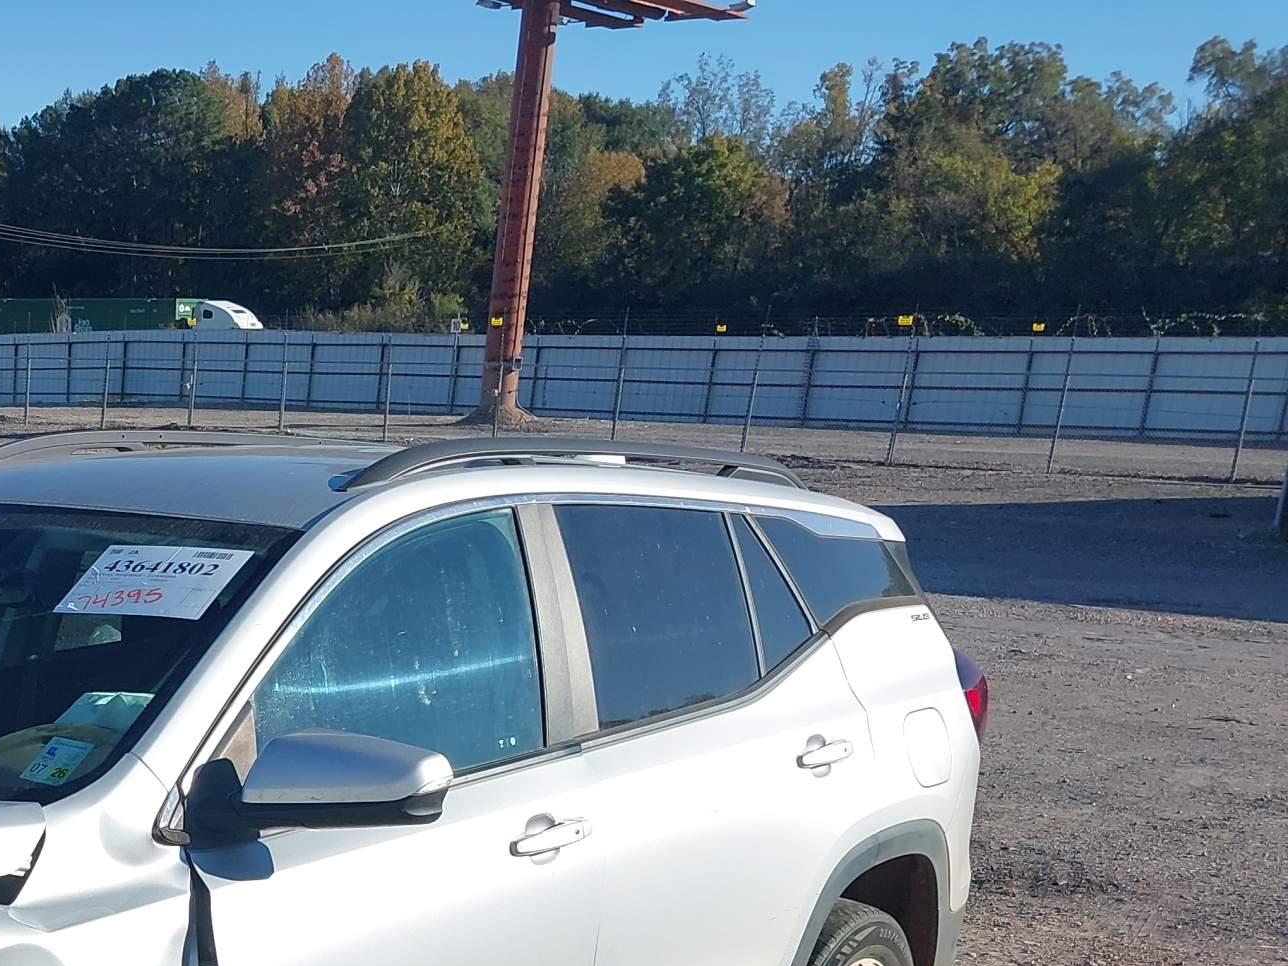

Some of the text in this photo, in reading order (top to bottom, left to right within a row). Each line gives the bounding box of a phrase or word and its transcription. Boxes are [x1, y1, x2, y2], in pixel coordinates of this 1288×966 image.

[104, 559, 220, 577] 43641802
[78, 587, 163, 611] 74395
[29, 762, 69, 779] 07 26
